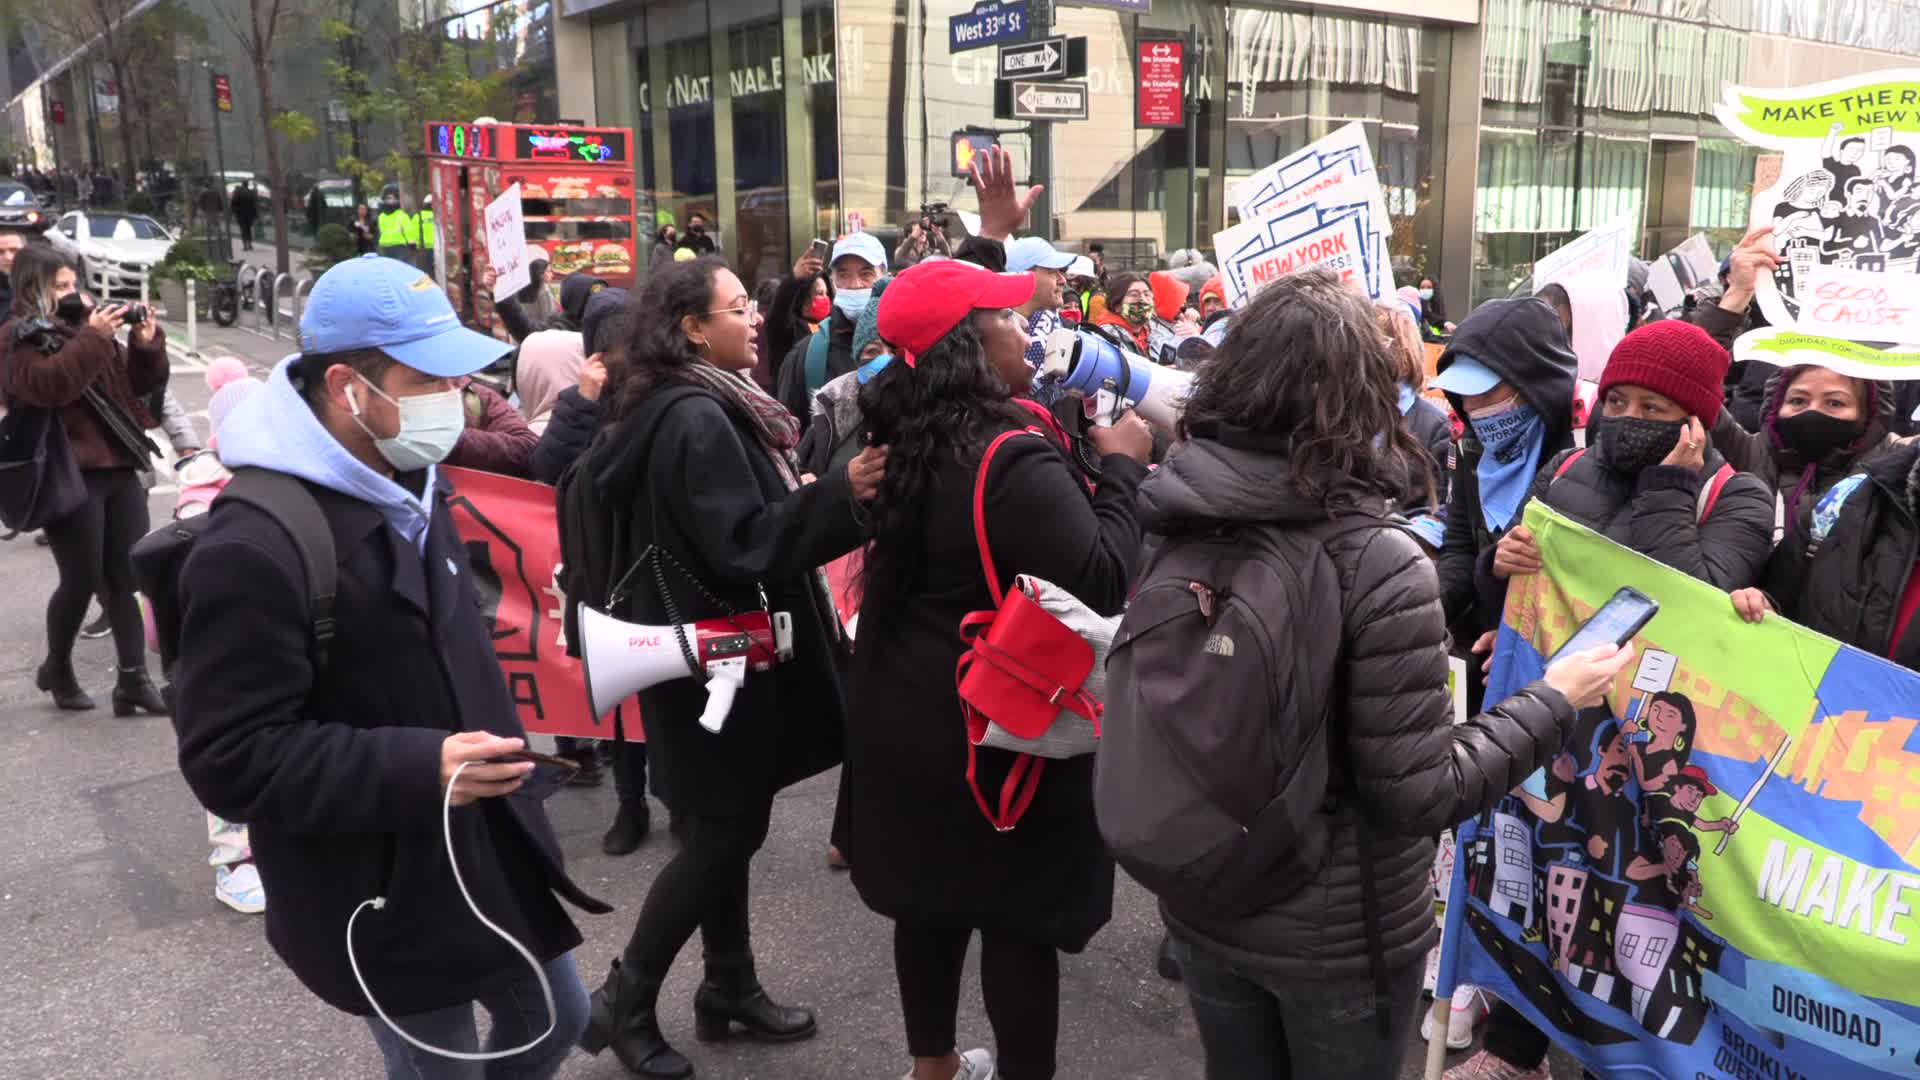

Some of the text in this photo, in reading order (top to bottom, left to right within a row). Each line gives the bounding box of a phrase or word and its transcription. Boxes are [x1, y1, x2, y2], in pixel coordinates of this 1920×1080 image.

[955, 11, 1021, 43] West 33rd St
[1009, 50, 1053, 68] ONE WAY
[1025, 94, 1074, 105] ONE WAY
[1762, 101, 1835, 122] MAKE
[1840, 89, 1892, 113] THE
[1857, 110, 1907, 126] NEW
[1252, 251, 1292, 285] NEW
[1296, 231, 1348, 265] YORK
[1812, 303, 1911, 326] CAUSE
[629, 636, 661, 648] PYLE
[1759, 838, 1920, 945] MAKE
